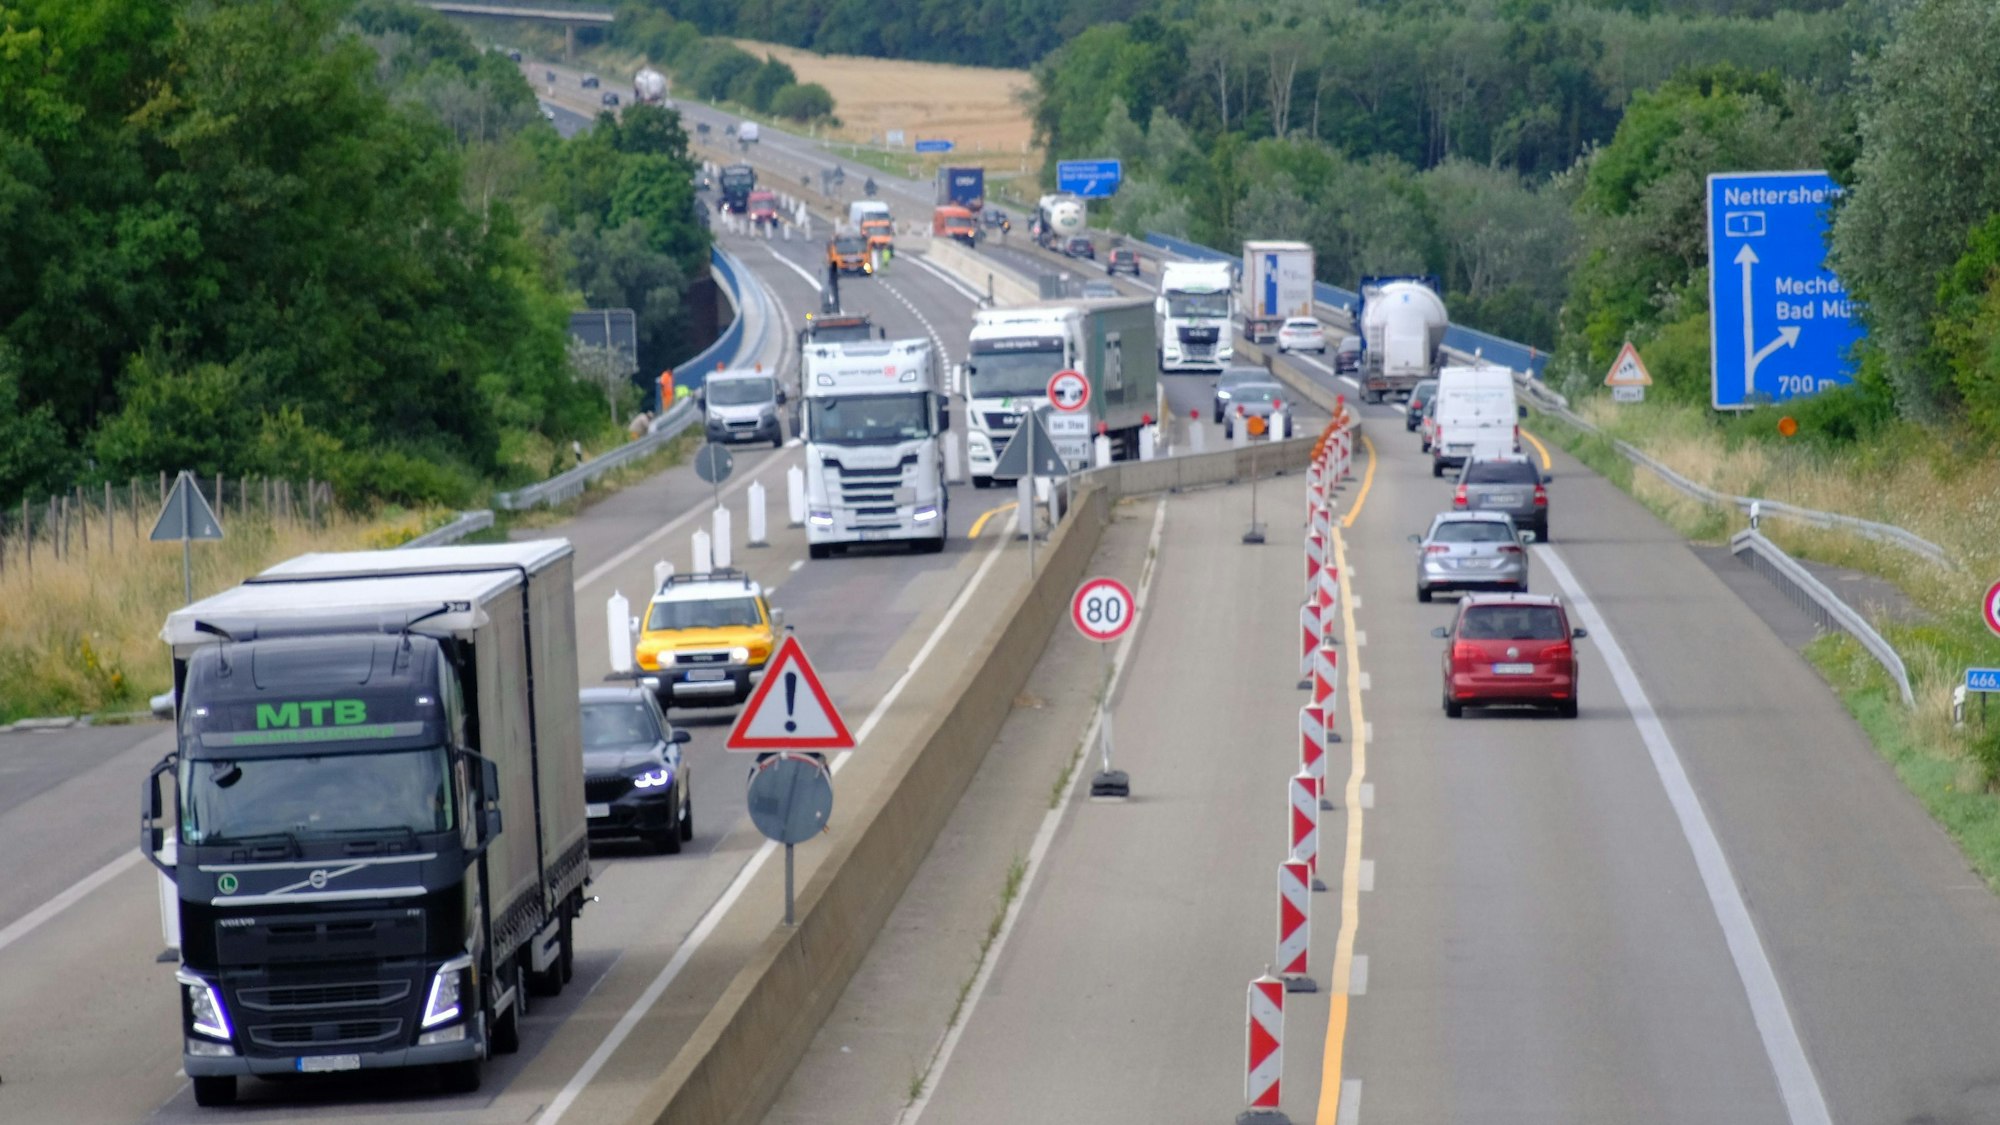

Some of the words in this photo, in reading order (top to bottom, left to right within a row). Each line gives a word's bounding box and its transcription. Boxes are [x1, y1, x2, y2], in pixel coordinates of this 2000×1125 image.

[1742, 215, 1749, 232] 1
[1775, 275, 1845, 295] Meche
[1776, 300, 1815, 320] Bad
[1778, 374, 1814, 394] 700
[1087, 597, 1120, 623] 80
[256, 699, 367, 730] MTB
[223, 875, 234, 891] L
